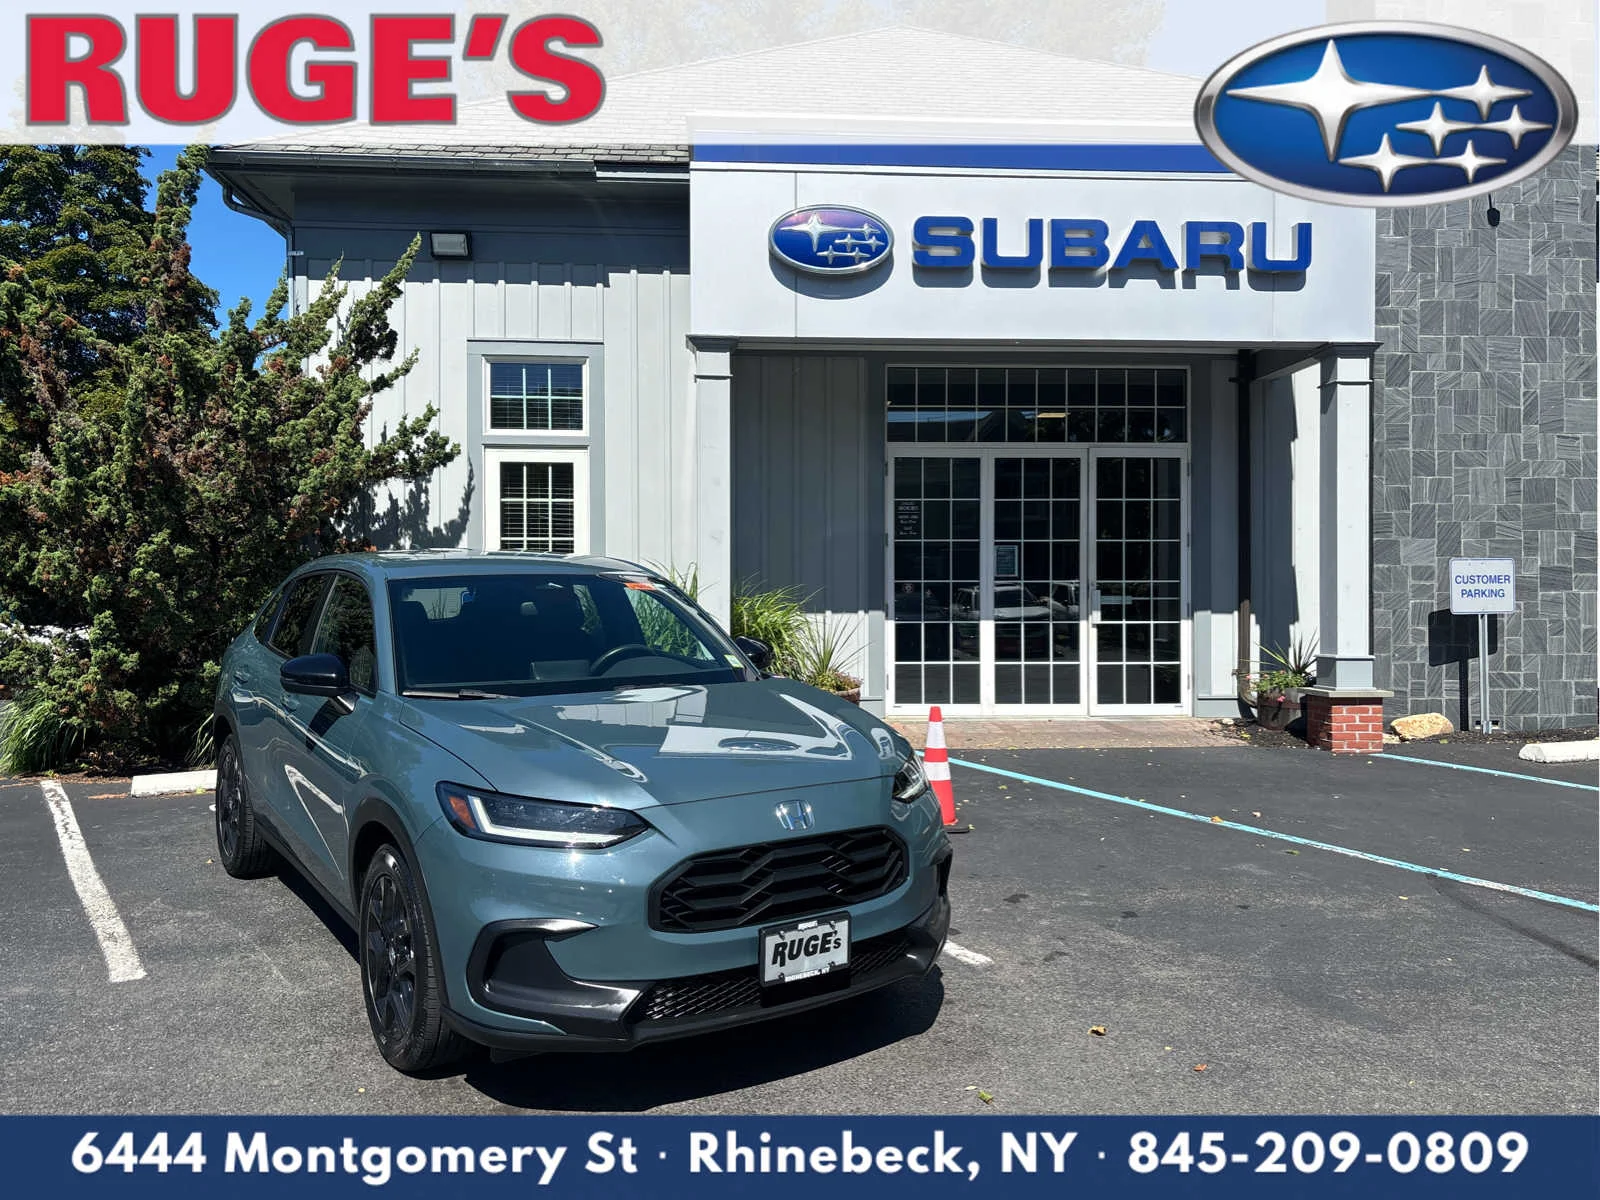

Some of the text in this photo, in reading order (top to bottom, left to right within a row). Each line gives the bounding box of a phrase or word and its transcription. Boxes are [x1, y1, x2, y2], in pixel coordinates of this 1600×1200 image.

[912, 215, 1313, 272] SUBARU
[1454, 574, 1511, 585] CUSTOMER
[1460, 588, 1505, 598] PARKING
